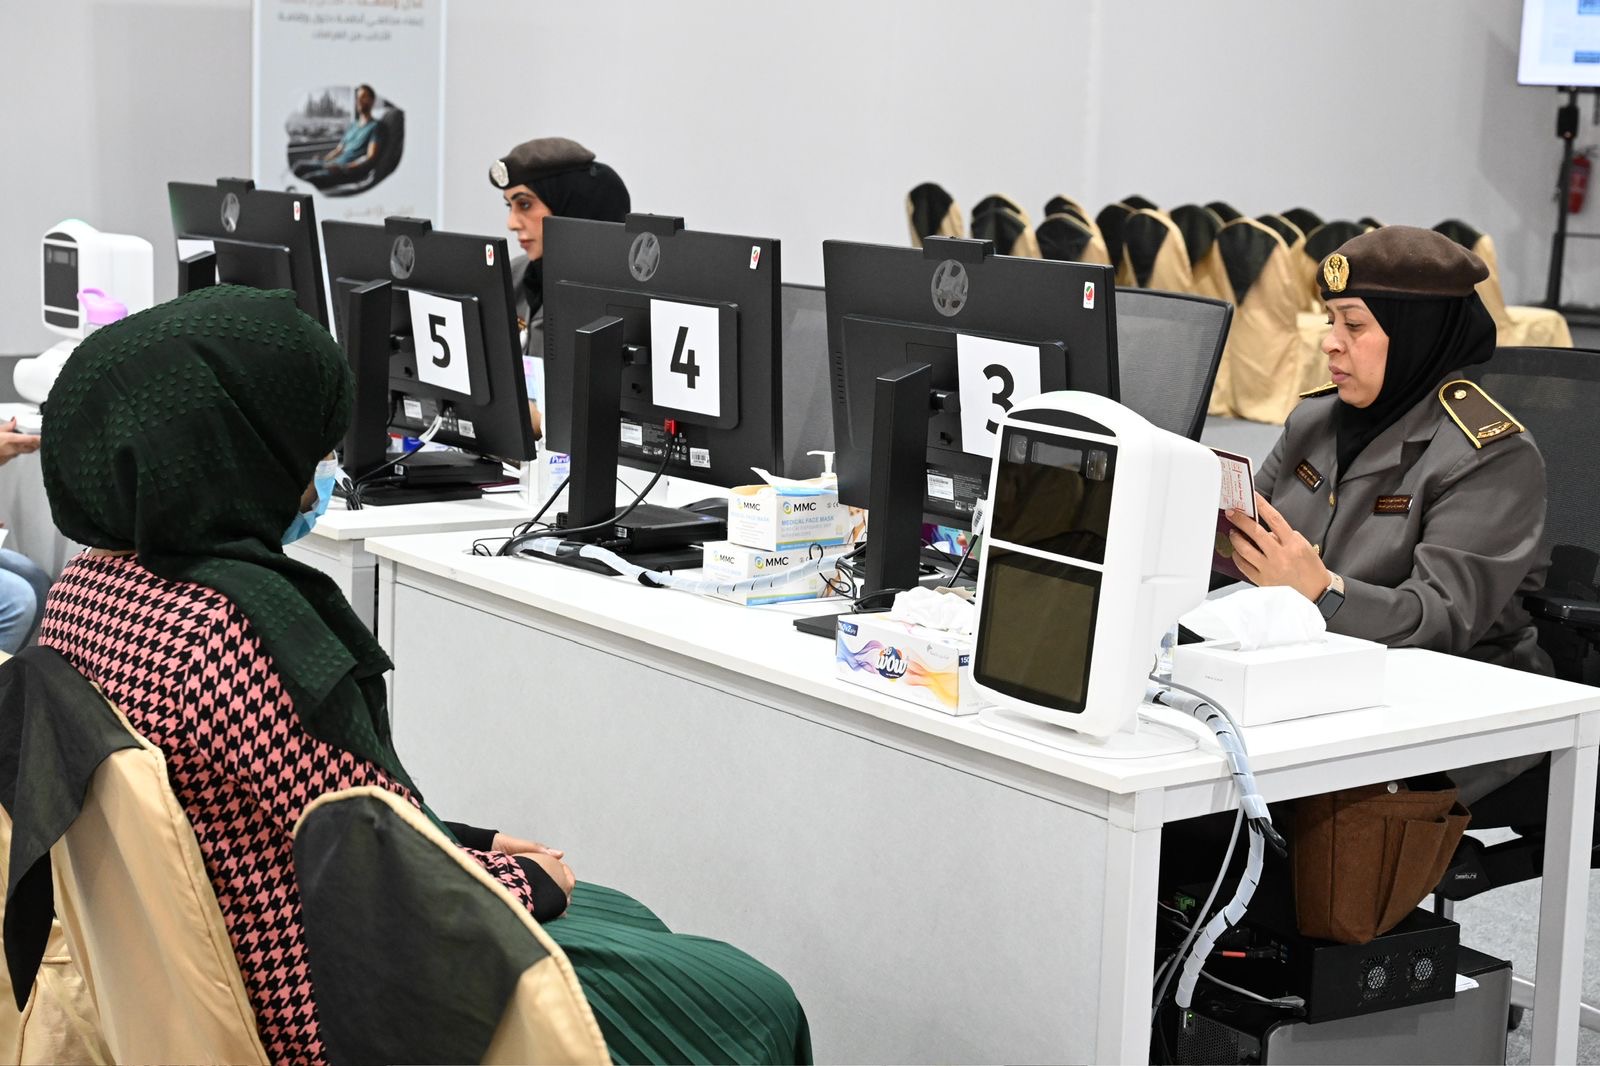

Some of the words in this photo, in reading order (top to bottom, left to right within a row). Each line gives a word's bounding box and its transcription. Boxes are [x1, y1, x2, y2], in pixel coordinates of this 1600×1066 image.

[428, 313, 451, 368] 5
[670, 326, 700, 389] 4
[983, 364, 1015, 435] 3
[743, 502, 761, 511] MMC
[793, 502, 817, 512] MMC
[765, 557, 789, 567] MMC
